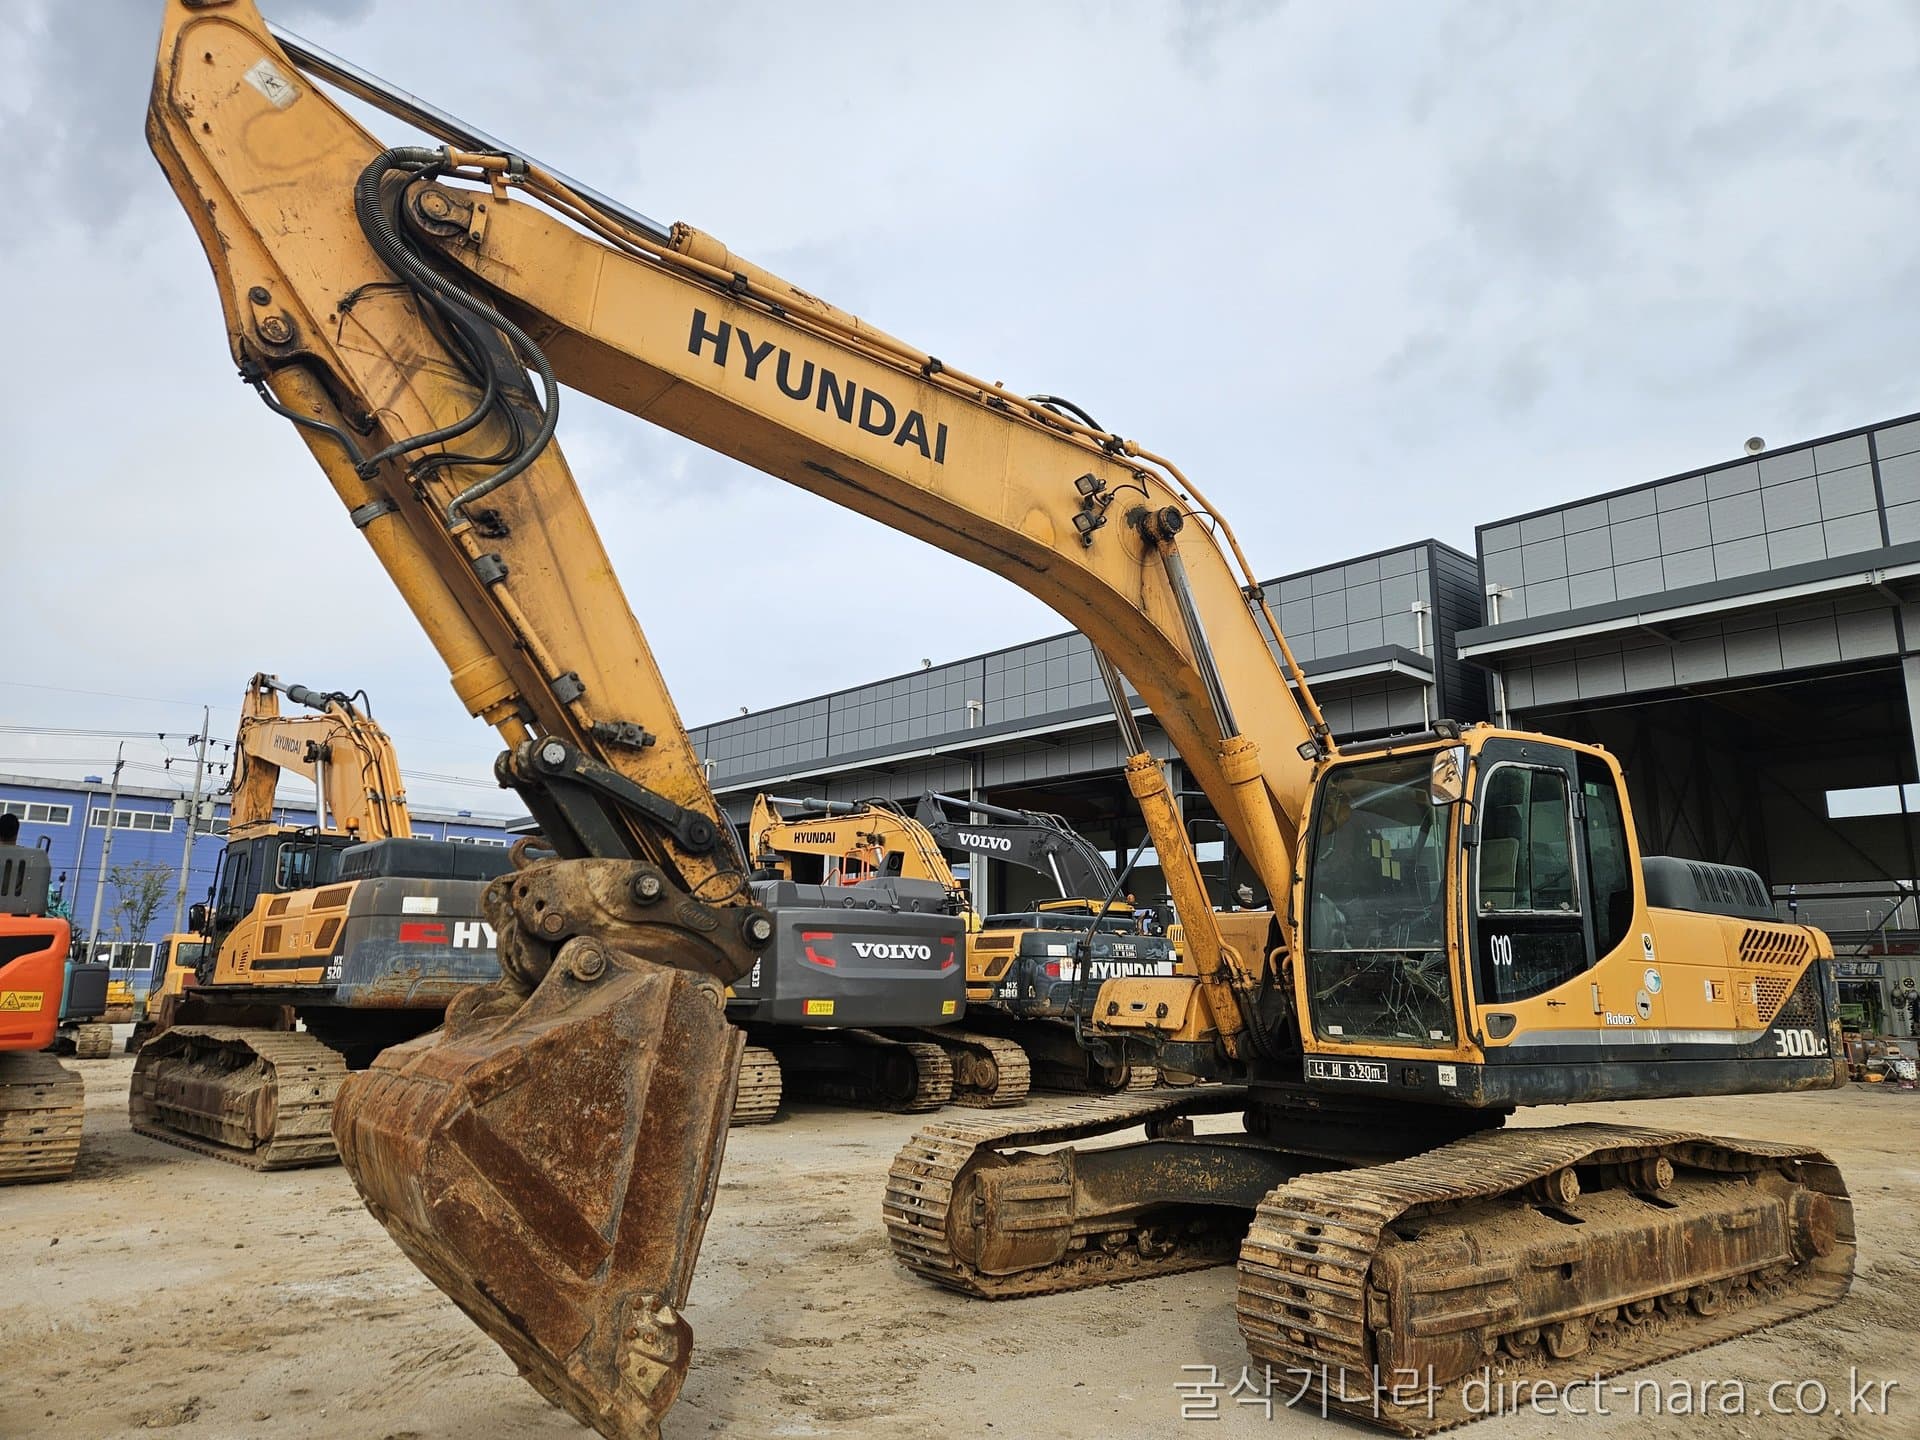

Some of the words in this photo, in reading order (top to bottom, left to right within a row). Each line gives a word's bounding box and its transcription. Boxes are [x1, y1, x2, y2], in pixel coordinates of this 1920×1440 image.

[687, 308, 948, 465] HYUNDAI
[274, 735, 301, 754] HYUNDAI
[793, 831, 836, 844] HYUNDAI
[957, 832, 1012, 851] VOLVO
[852, 942, 931, 960] VOLVO
[1490, 934, 1512, 966] 010
[333, 955, 343, 966] HX
[327, 966, 342, 979] 520
[999, 988, 1018, 998] 380
[1006, 981, 1018, 989] HX
[1349, 1064, 1381, 1080] 3.20m
